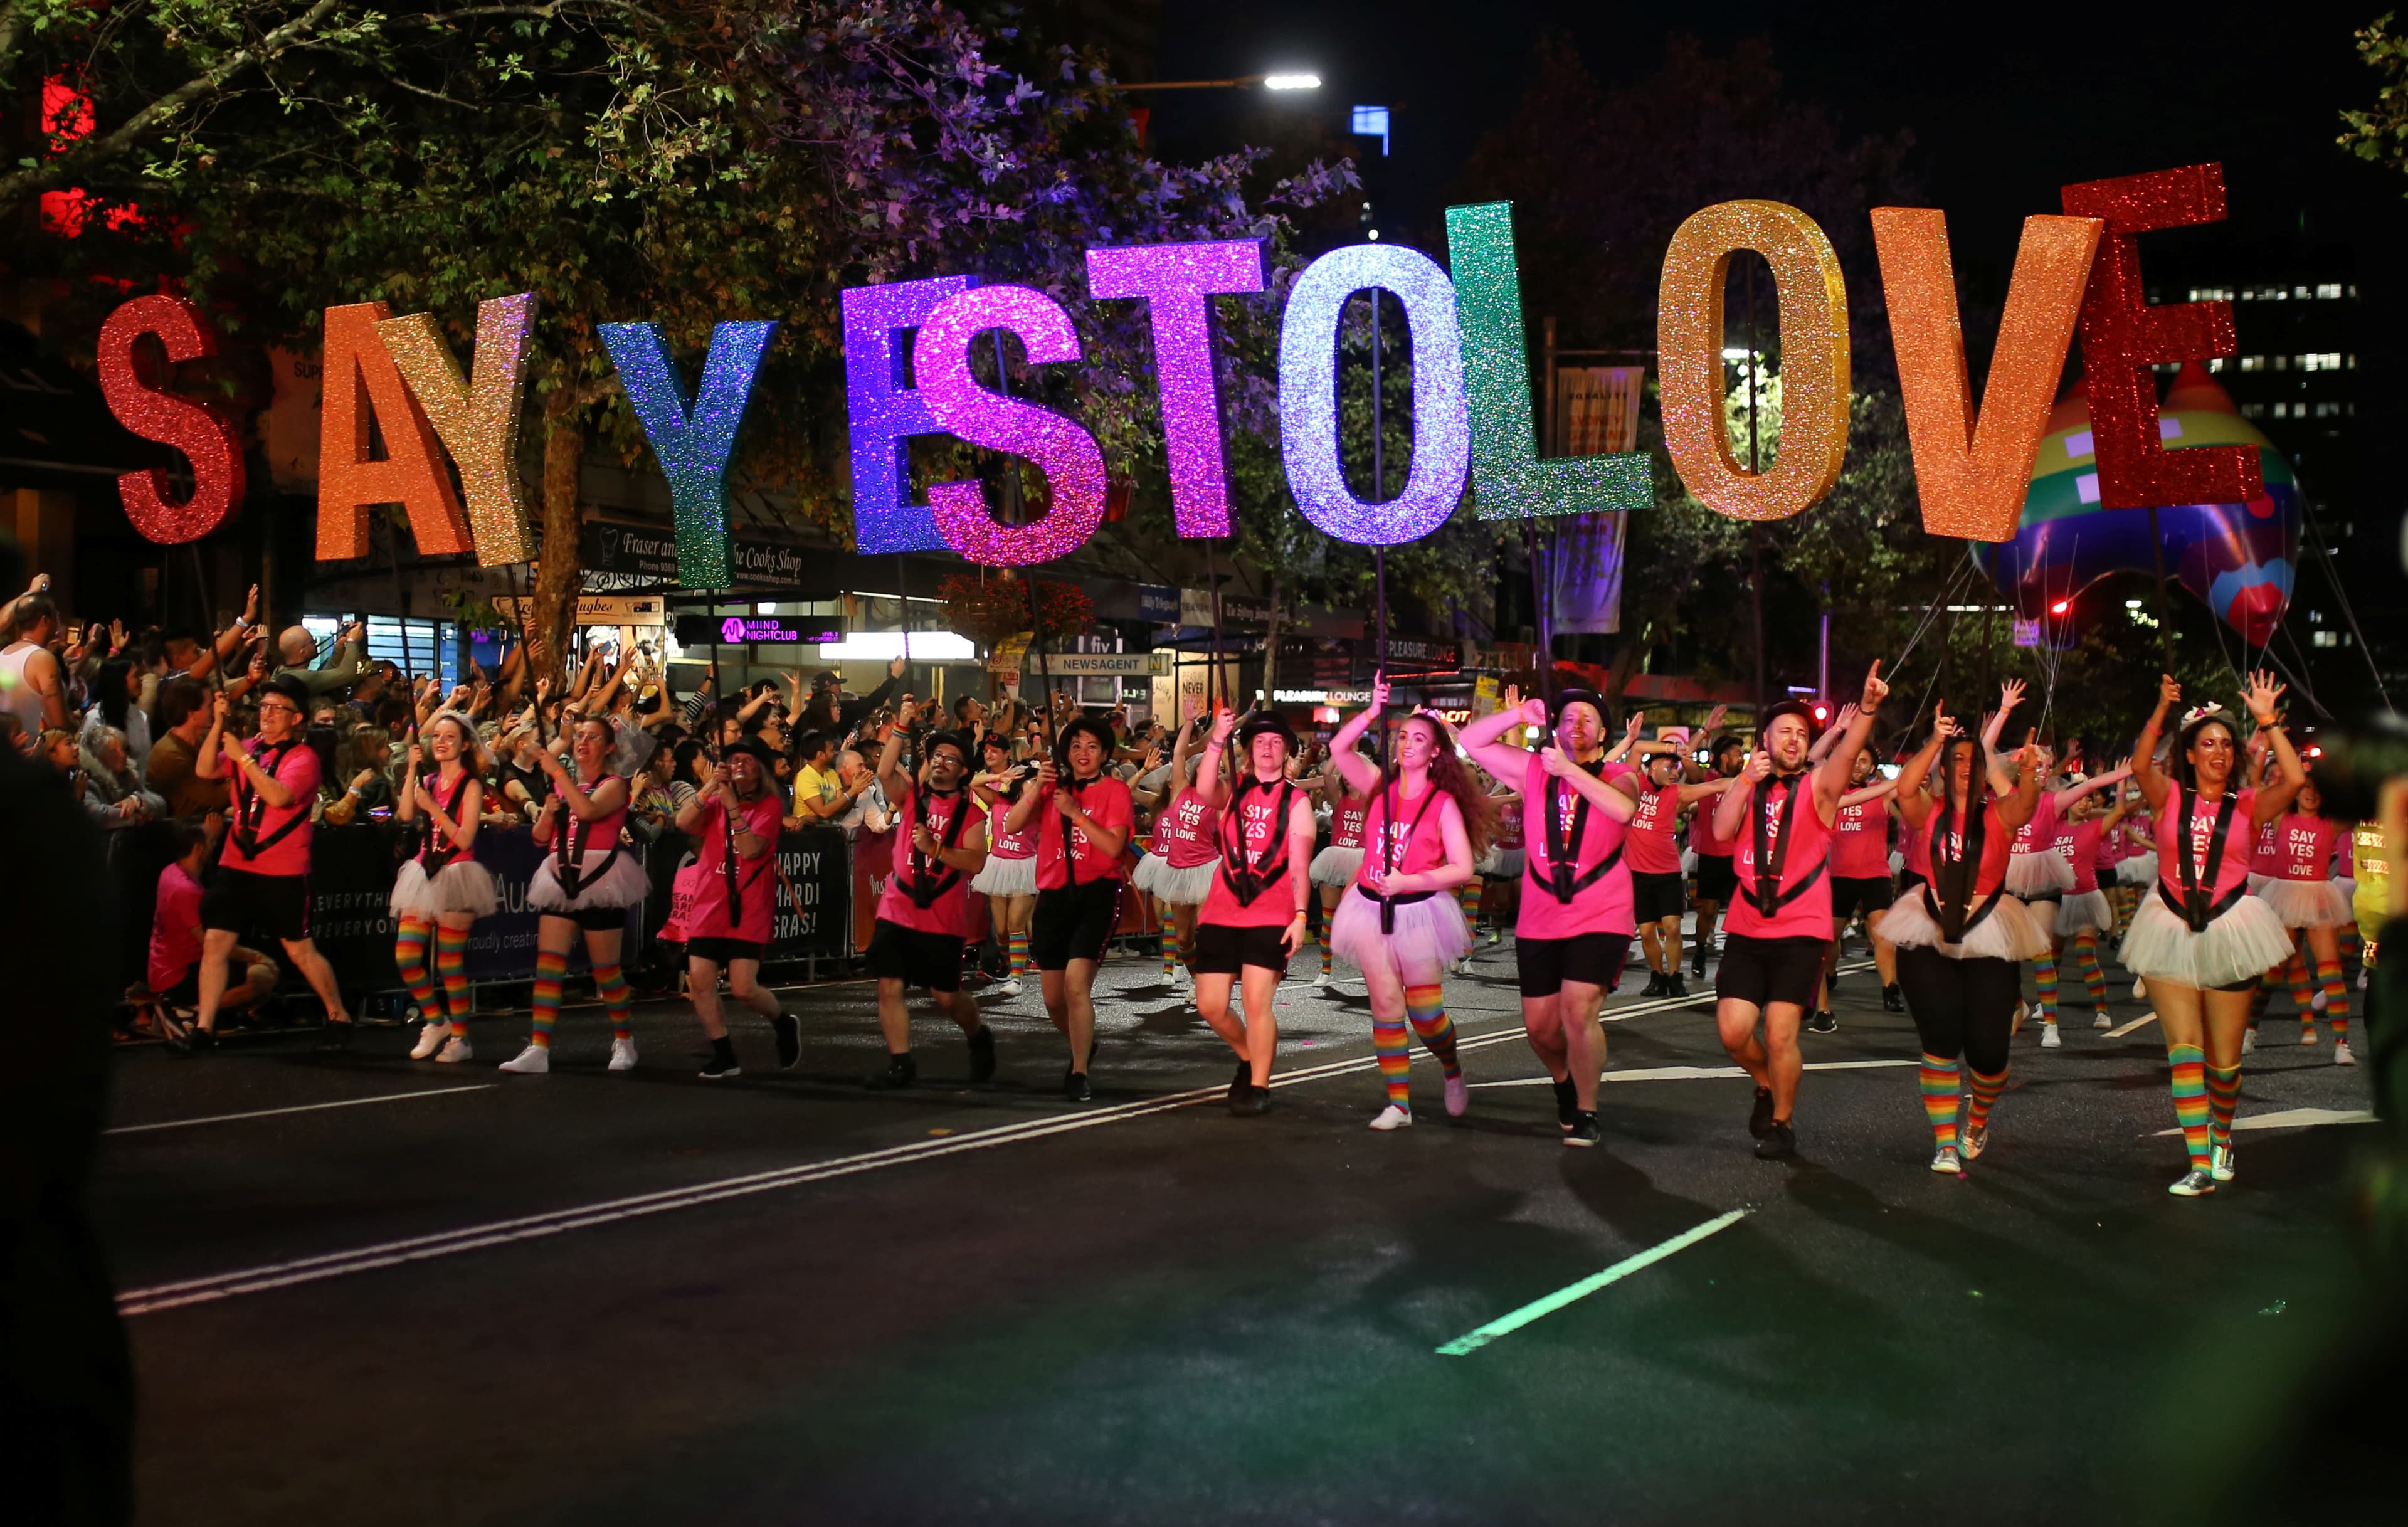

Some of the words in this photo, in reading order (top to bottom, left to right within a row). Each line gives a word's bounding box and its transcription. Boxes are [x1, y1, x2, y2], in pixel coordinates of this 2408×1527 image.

[623, 533, 659, 556] Fraser
[746, 547, 776, 573] Cooks
[776, 547, 802, 578] Shop
[638, 559, 659, 571] Phone
[746, 620, 779, 631] MIIND
[746, 630, 798, 642] NIGHTCLUB
[1388, 640, 1427, 660] PLEASURE
[1063, 658, 1139, 670] NEWSAGENT
[1182, 682, 1204, 694] NEVER
[1273, 690, 1328, 702] PLEASURE
[1329, 691, 1371, 702] LOUNGE
[1558, 793, 1580, 811] AY
[1640, 790, 1660, 806] SAY
[1181, 799, 1205, 815] SAY
[1244, 803, 1273, 820] SAY
[1637, 801, 1658, 816] YES
[1178, 809, 1201, 827] YES
[1343, 810, 1365, 822] SAY
[1504, 815, 1521, 824] SAY
[1342, 820, 1363, 833] YES
[1504, 823, 1521, 833] YES
[1632, 817, 1654, 831] LOVE
[1840, 821, 1862, 832] LOVE
[1175, 827, 1197, 842] LOVE
[2289, 828, 2316, 844] SAY
[998, 838, 1021, 853] LOVE
[1159, 843, 1170, 853] LO
[1337, 836, 1359, 848] LOVE
[2258, 845, 2276, 855] LOV
[2288, 842, 2315, 858] YES
